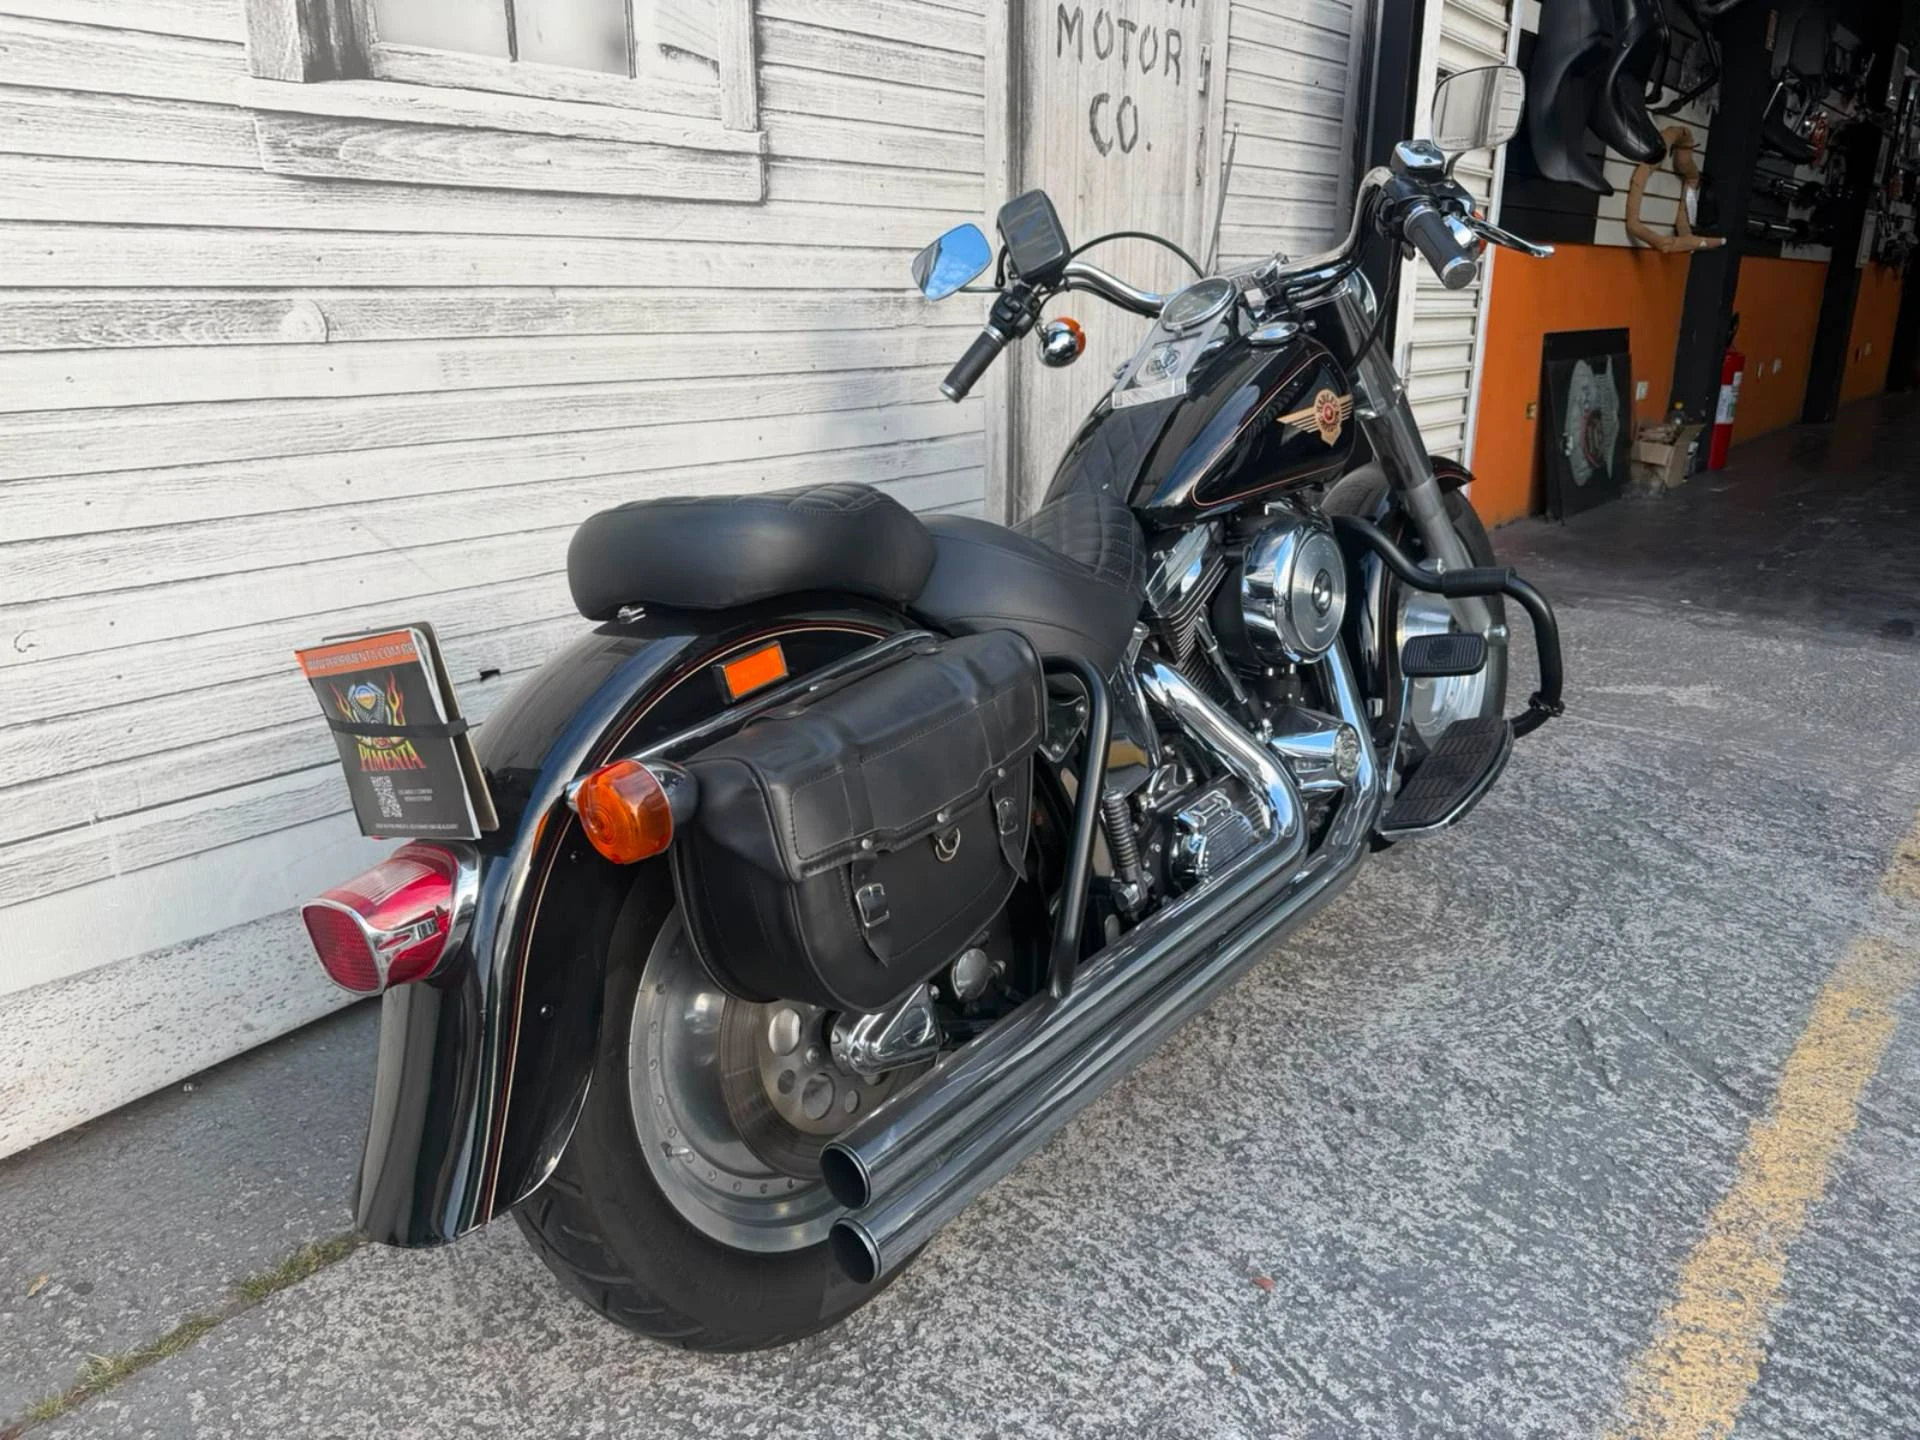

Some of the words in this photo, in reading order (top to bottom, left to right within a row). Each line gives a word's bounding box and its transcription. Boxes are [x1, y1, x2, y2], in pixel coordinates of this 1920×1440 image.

[1056, 3, 1183, 86] MOTOR
[1089, 92, 1151, 157] CO.
[357, 739, 427, 772] PIMENTA
